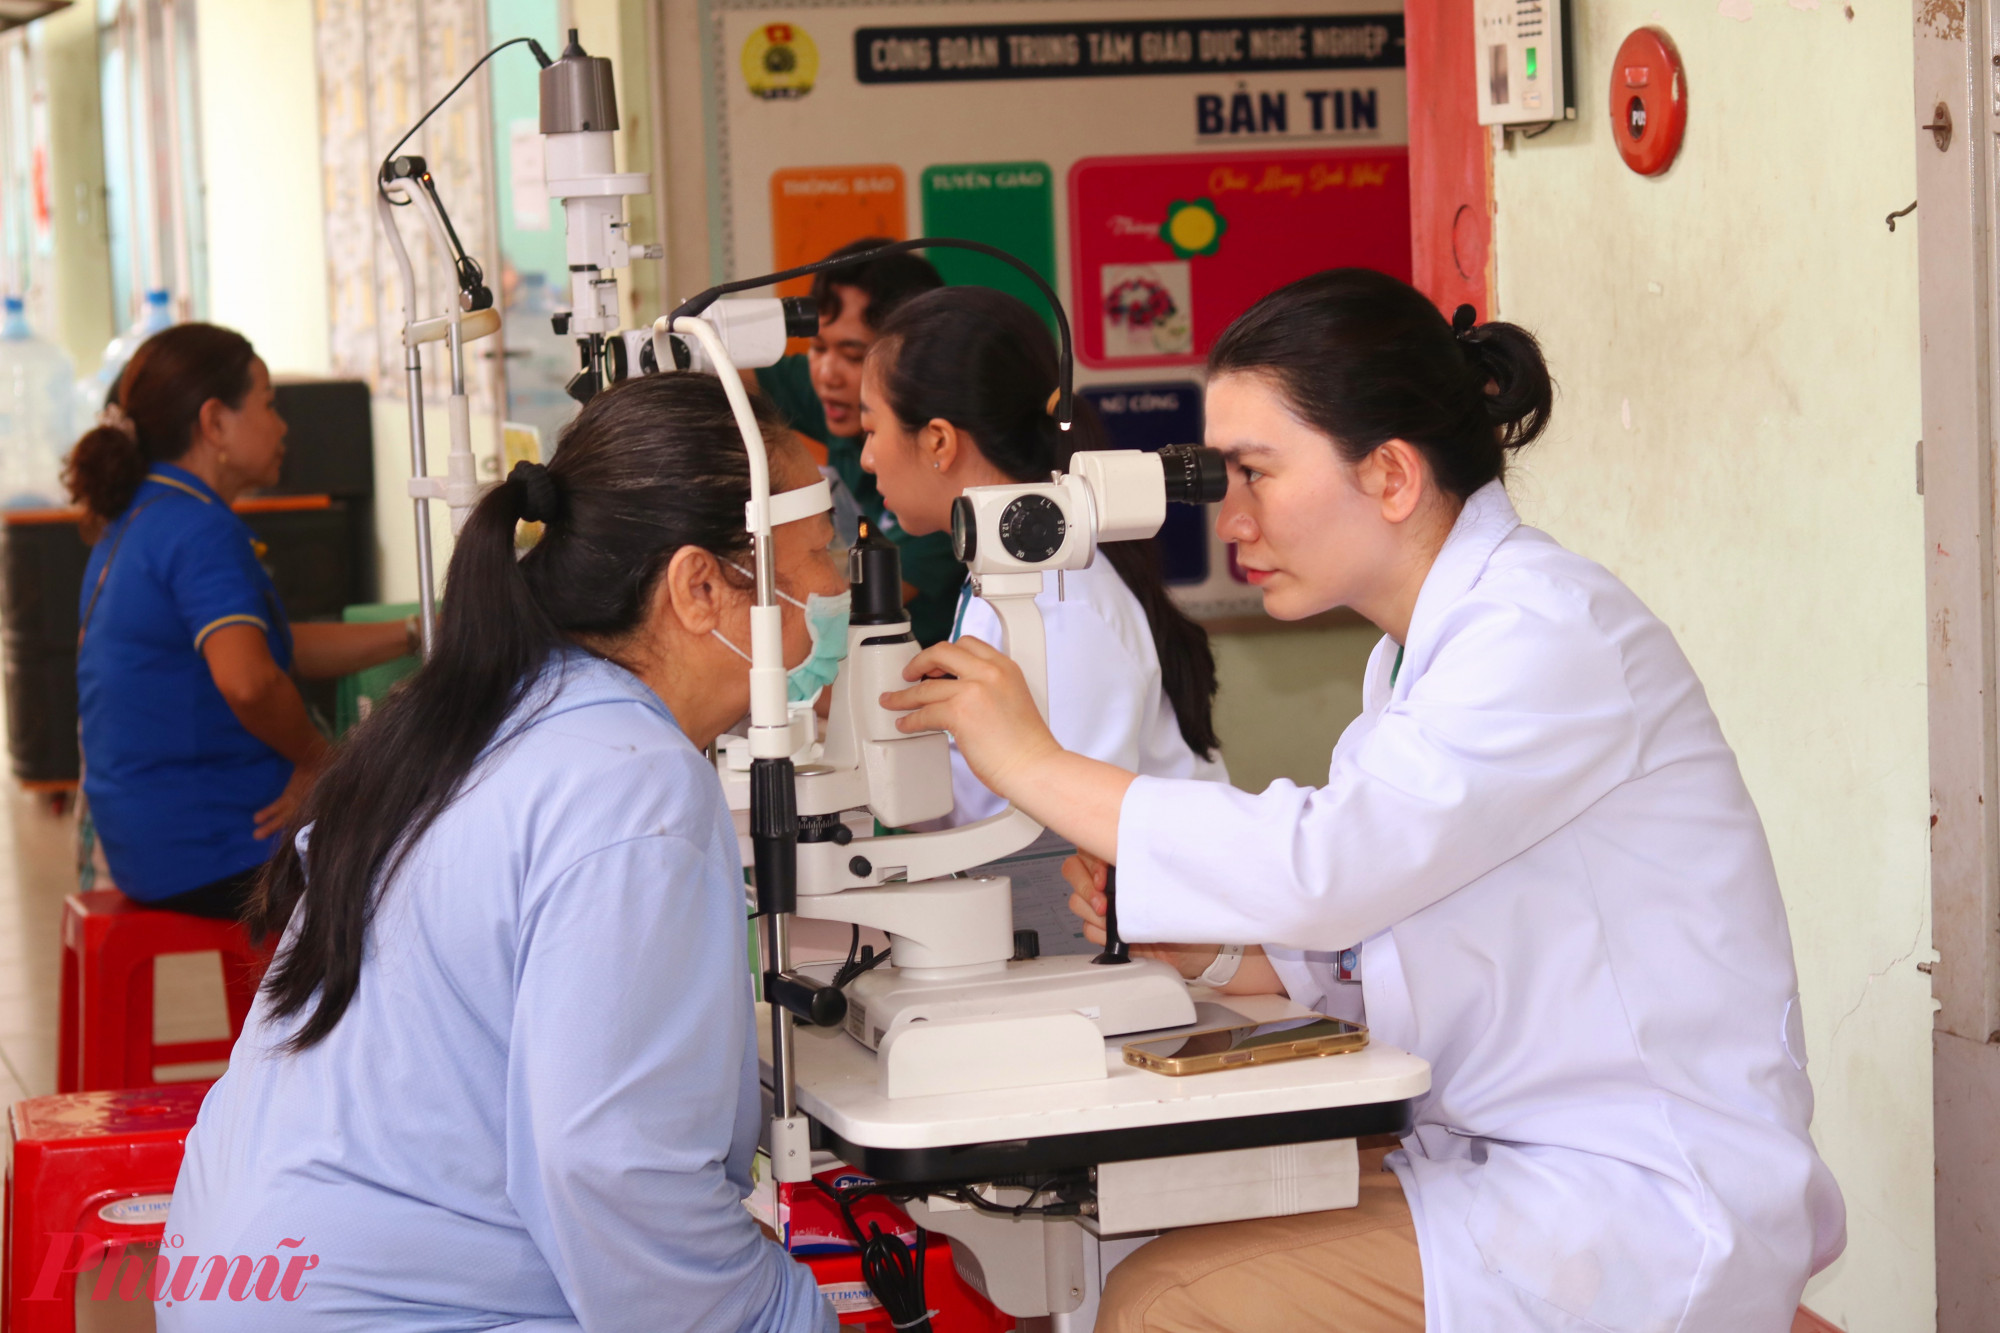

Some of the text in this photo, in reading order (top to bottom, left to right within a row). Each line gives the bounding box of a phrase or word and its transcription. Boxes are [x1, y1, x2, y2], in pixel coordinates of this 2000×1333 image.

[1006, 32, 1080, 66] TRUNG
[1196, 79, 1378, 135] BẢN TIN
